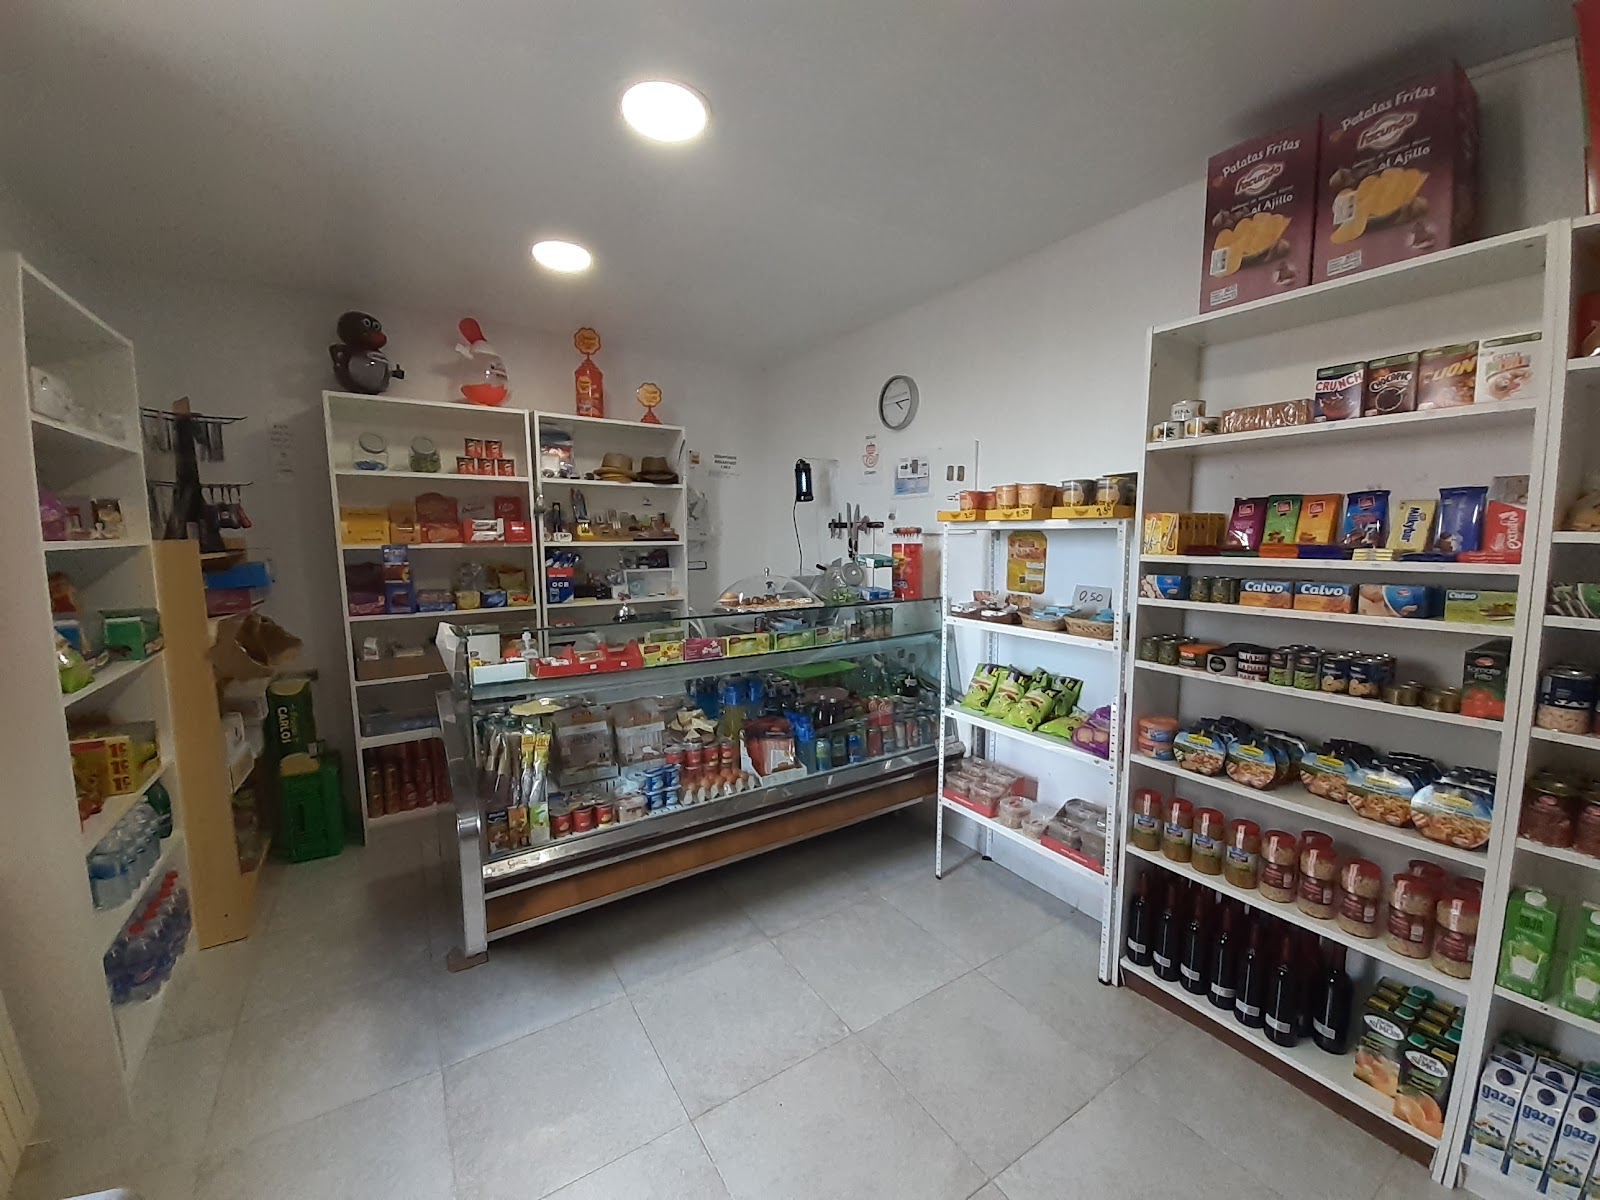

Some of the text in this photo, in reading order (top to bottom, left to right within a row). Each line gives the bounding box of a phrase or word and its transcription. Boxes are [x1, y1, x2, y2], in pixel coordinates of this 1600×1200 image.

[1341, 85, 1437, 131] Patatas Fritas
[1222, 138, 1300, 178] Patatas Fritas
[1378, 160, 1390, 171] al
[1394, 145, 1431, 166] Ajillo
[1251, 202, 1262, 214] al
[1264, 193, 1293, 211] Ajillo
[1433, 356, 1477, 380] LION
[1315, 371, 1363, 392] CRUNCH
[1369, 371, 1412, 392] CHOCAPIC
[1402, 507, 1420, 543] Milkybar
[1079, 590, 1103, 603] 0,50
[1245, 581, 1284, 594] Calvo
[1300, 582, 1344, 597] Calvo
[1449, 591, 1476, 600] Calvo
[1467, 665, 1502, 676] Tomate
[1481, 1084, 1516, 1107] gaza
[1522, 1104, 1556, 1127] gaza
[1563, 1123, 1597, 1145] gaza
